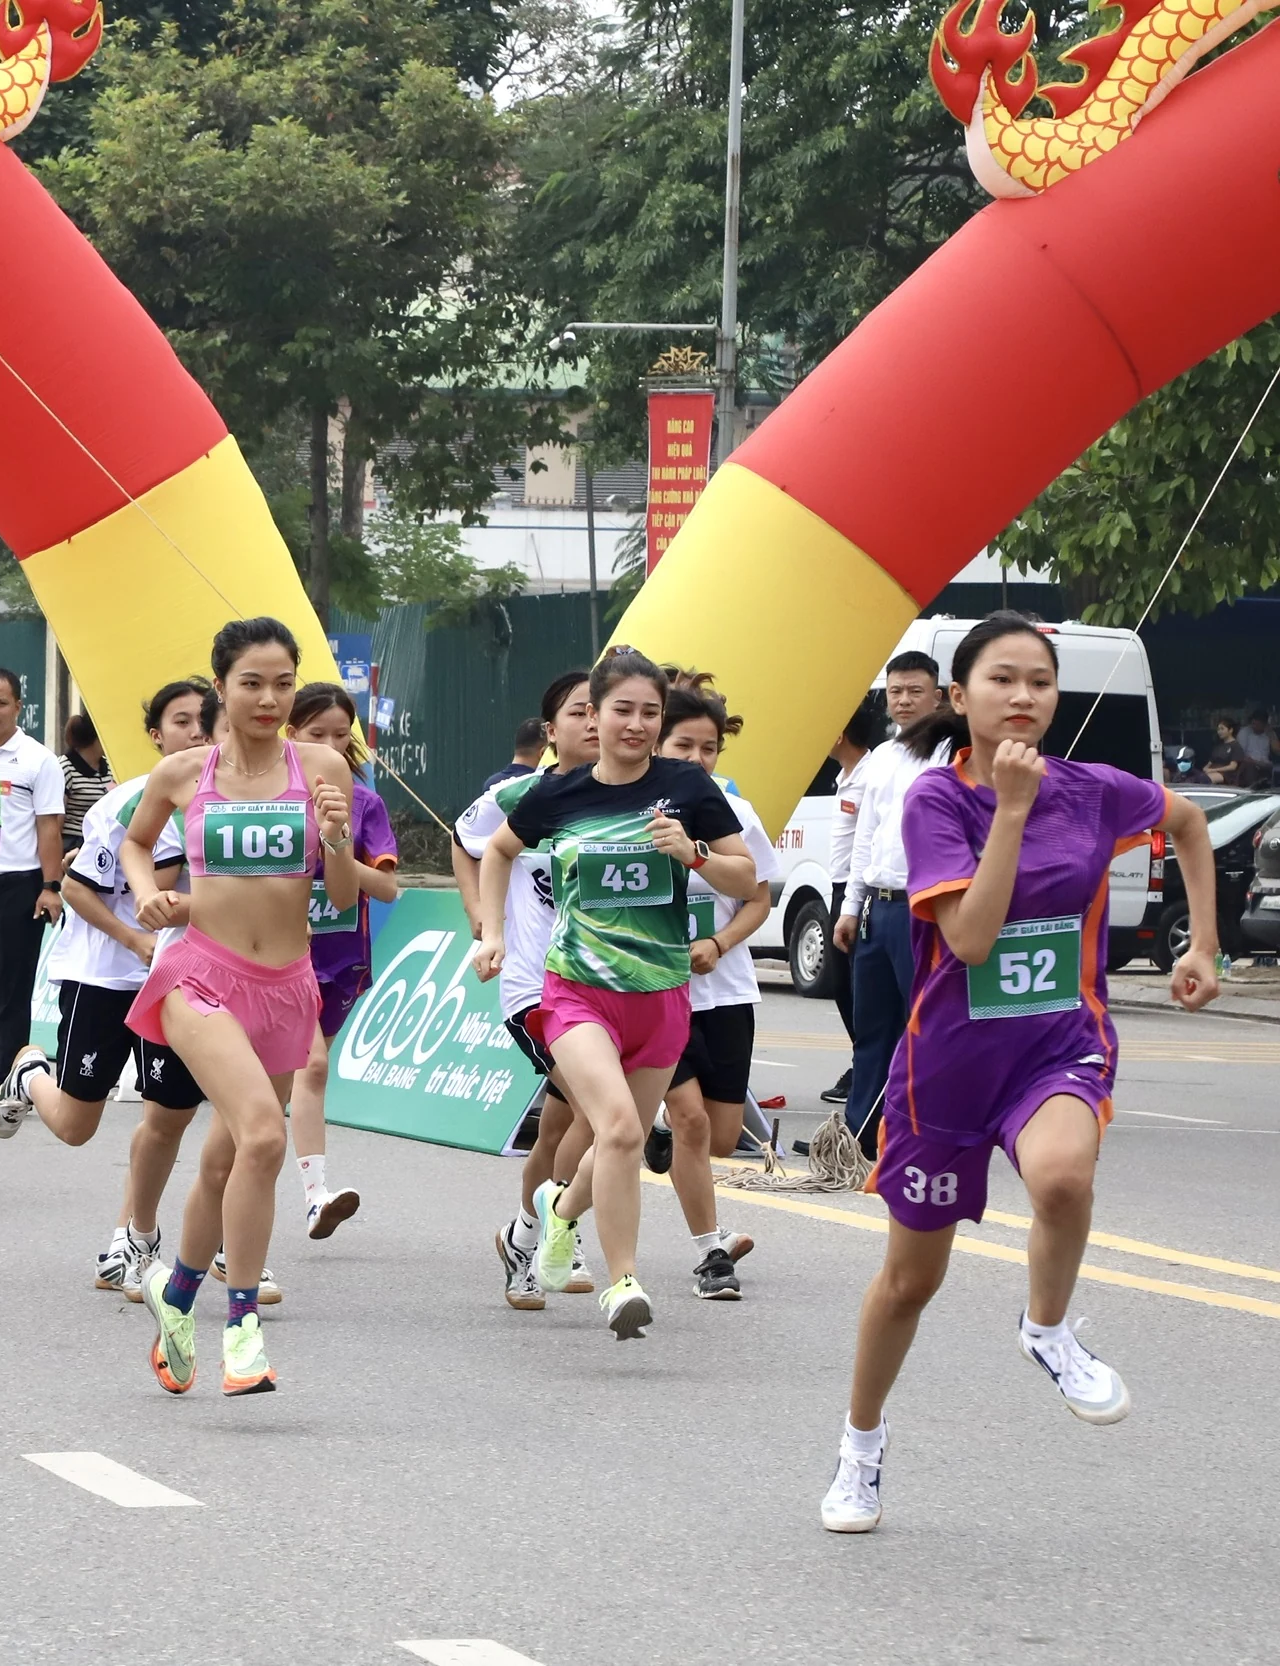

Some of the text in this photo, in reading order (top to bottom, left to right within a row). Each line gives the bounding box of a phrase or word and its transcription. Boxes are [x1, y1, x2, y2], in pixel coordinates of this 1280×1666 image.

[683, 419, 695, 434] CAO
[681, 443, 693, 458] QUẢ
[678, 464, 692, 480] PHÁP
[216, 824, 293, 858] 103
[602, 844, 615, 852] CÚP
[616, 844, 631, 852] GIẤY
[601, 862, 649, 892] 43
[308, 898, 340, 922] 44
[1001, 926, 1018, 935] CÚP
[1021, 925, 1038, 934] GIẤY
[999, 948, 1056, 995] 52
[452, 1011, 491, 1054] Nhịp
[362, 1061, 422, 1089] BAI BANG
[442, 1064, 481, 1099] thức
[476, 1068, 515, 1111] Việt
[903, 1165, 958, 1206] 38
